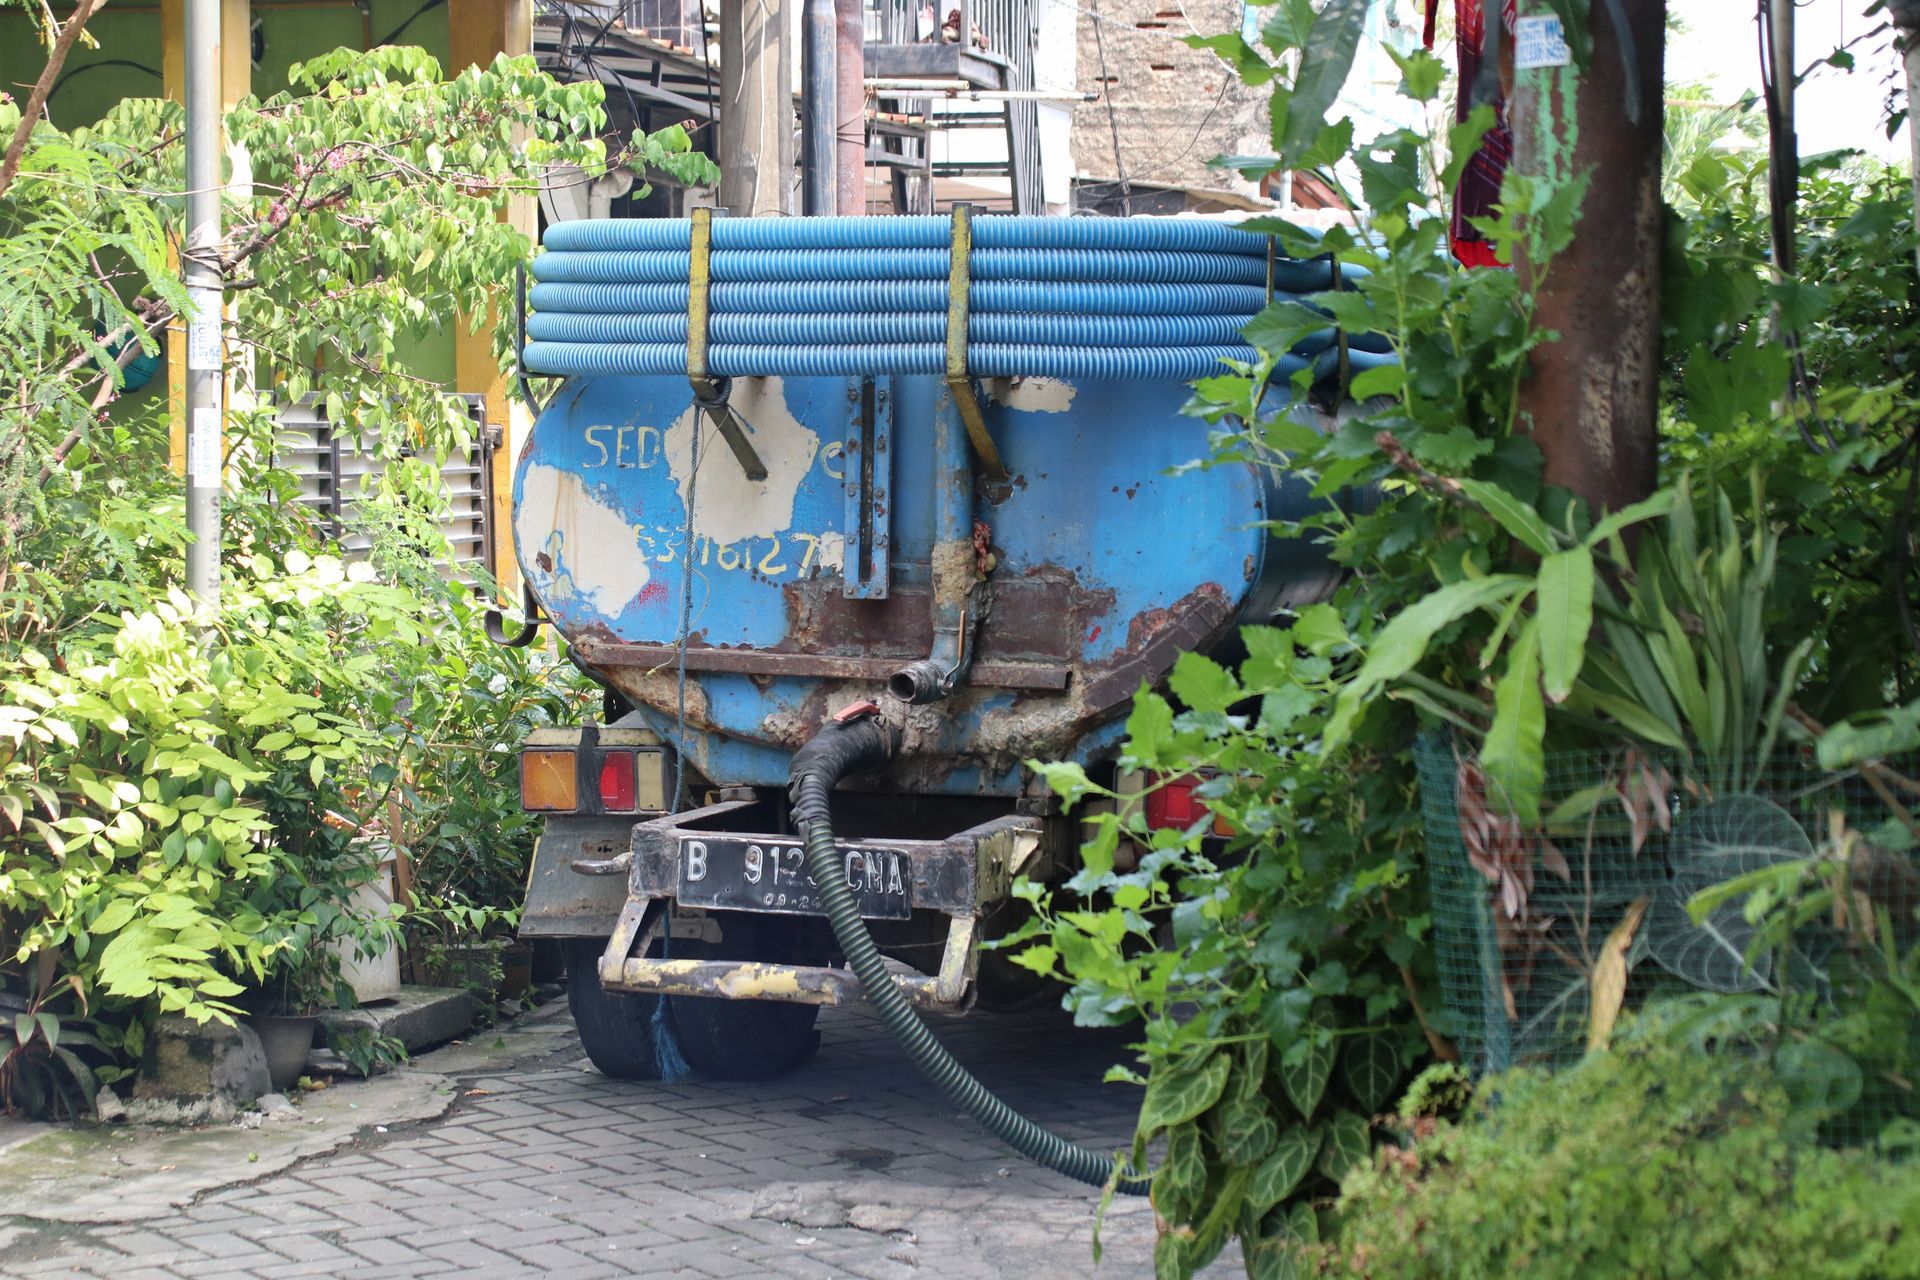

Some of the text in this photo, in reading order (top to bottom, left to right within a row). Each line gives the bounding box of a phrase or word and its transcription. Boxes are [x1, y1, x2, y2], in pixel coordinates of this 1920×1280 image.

[688, 842, 904, 895] B 912 CNA
